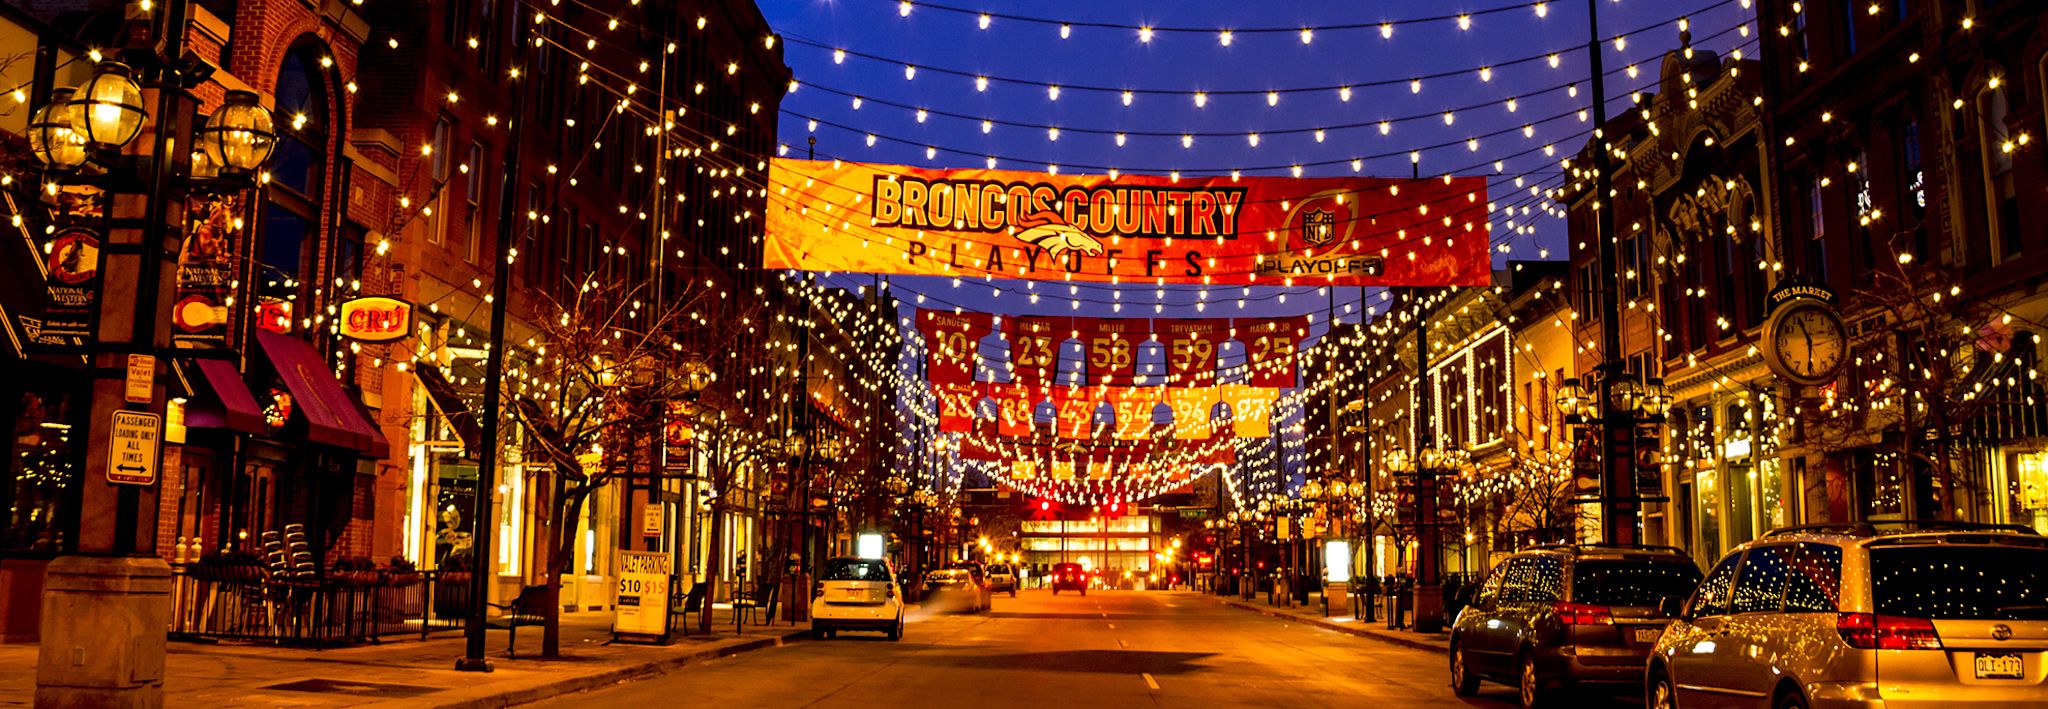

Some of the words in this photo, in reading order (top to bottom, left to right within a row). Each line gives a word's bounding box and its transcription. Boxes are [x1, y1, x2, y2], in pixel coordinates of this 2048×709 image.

[873, 176, 1057, 232] BRONCOS
[1063, 186, 1245, 238] COUNTRY
[1306, 224, 1331, 241] NFL
[908, 241, 1202, 277] PLAYOFFS
[1263, 259, 1375, 274] PLAYOFFS
[1772, 288, 1791, 302] THE
[1791, 286, 1833, 301] MARKET
[349, 305, 405, 333] CRÚ
[936, 316, 971, 328] SANDERS
[1020, 321, 1050, 332] HILAN
[1250, 324, 1277, 333] HARRS
[1280, 322, 1290, 332] JR
[1099, 324, 1124, 333] MILLER
[1170, 324, 1212, 334] TREVATHAN
[938, 331, 967, 361] 10
[1018, 336, 1053, 367] 23
[1091, 338, 1131, 368] 58
[1172, 338, 1212, 369] 59
[1254, 336, 1292, 368] 25
[131, 368, 151, 377] Valet
[943, 394, 972, 418] 23
[1001, 398, 1030, 422] 88
[1060, 400, 1090, 424] 43
[1118, 402, 1148, 424] 54
[116, 416, 156, 427] PASSENGER
[116, 428, 138, 439] LOADING
[140, 431, 154, 440] ONLY
[126, 441, 140, 450] ALL
[122, 452, 143, 462] TIMES
[622, 554, 640, 572] VALET
[640, 555, 666, 574] PARKING
[620, 578, 640, 593] $10
[644, 580, 664, 594] $15
